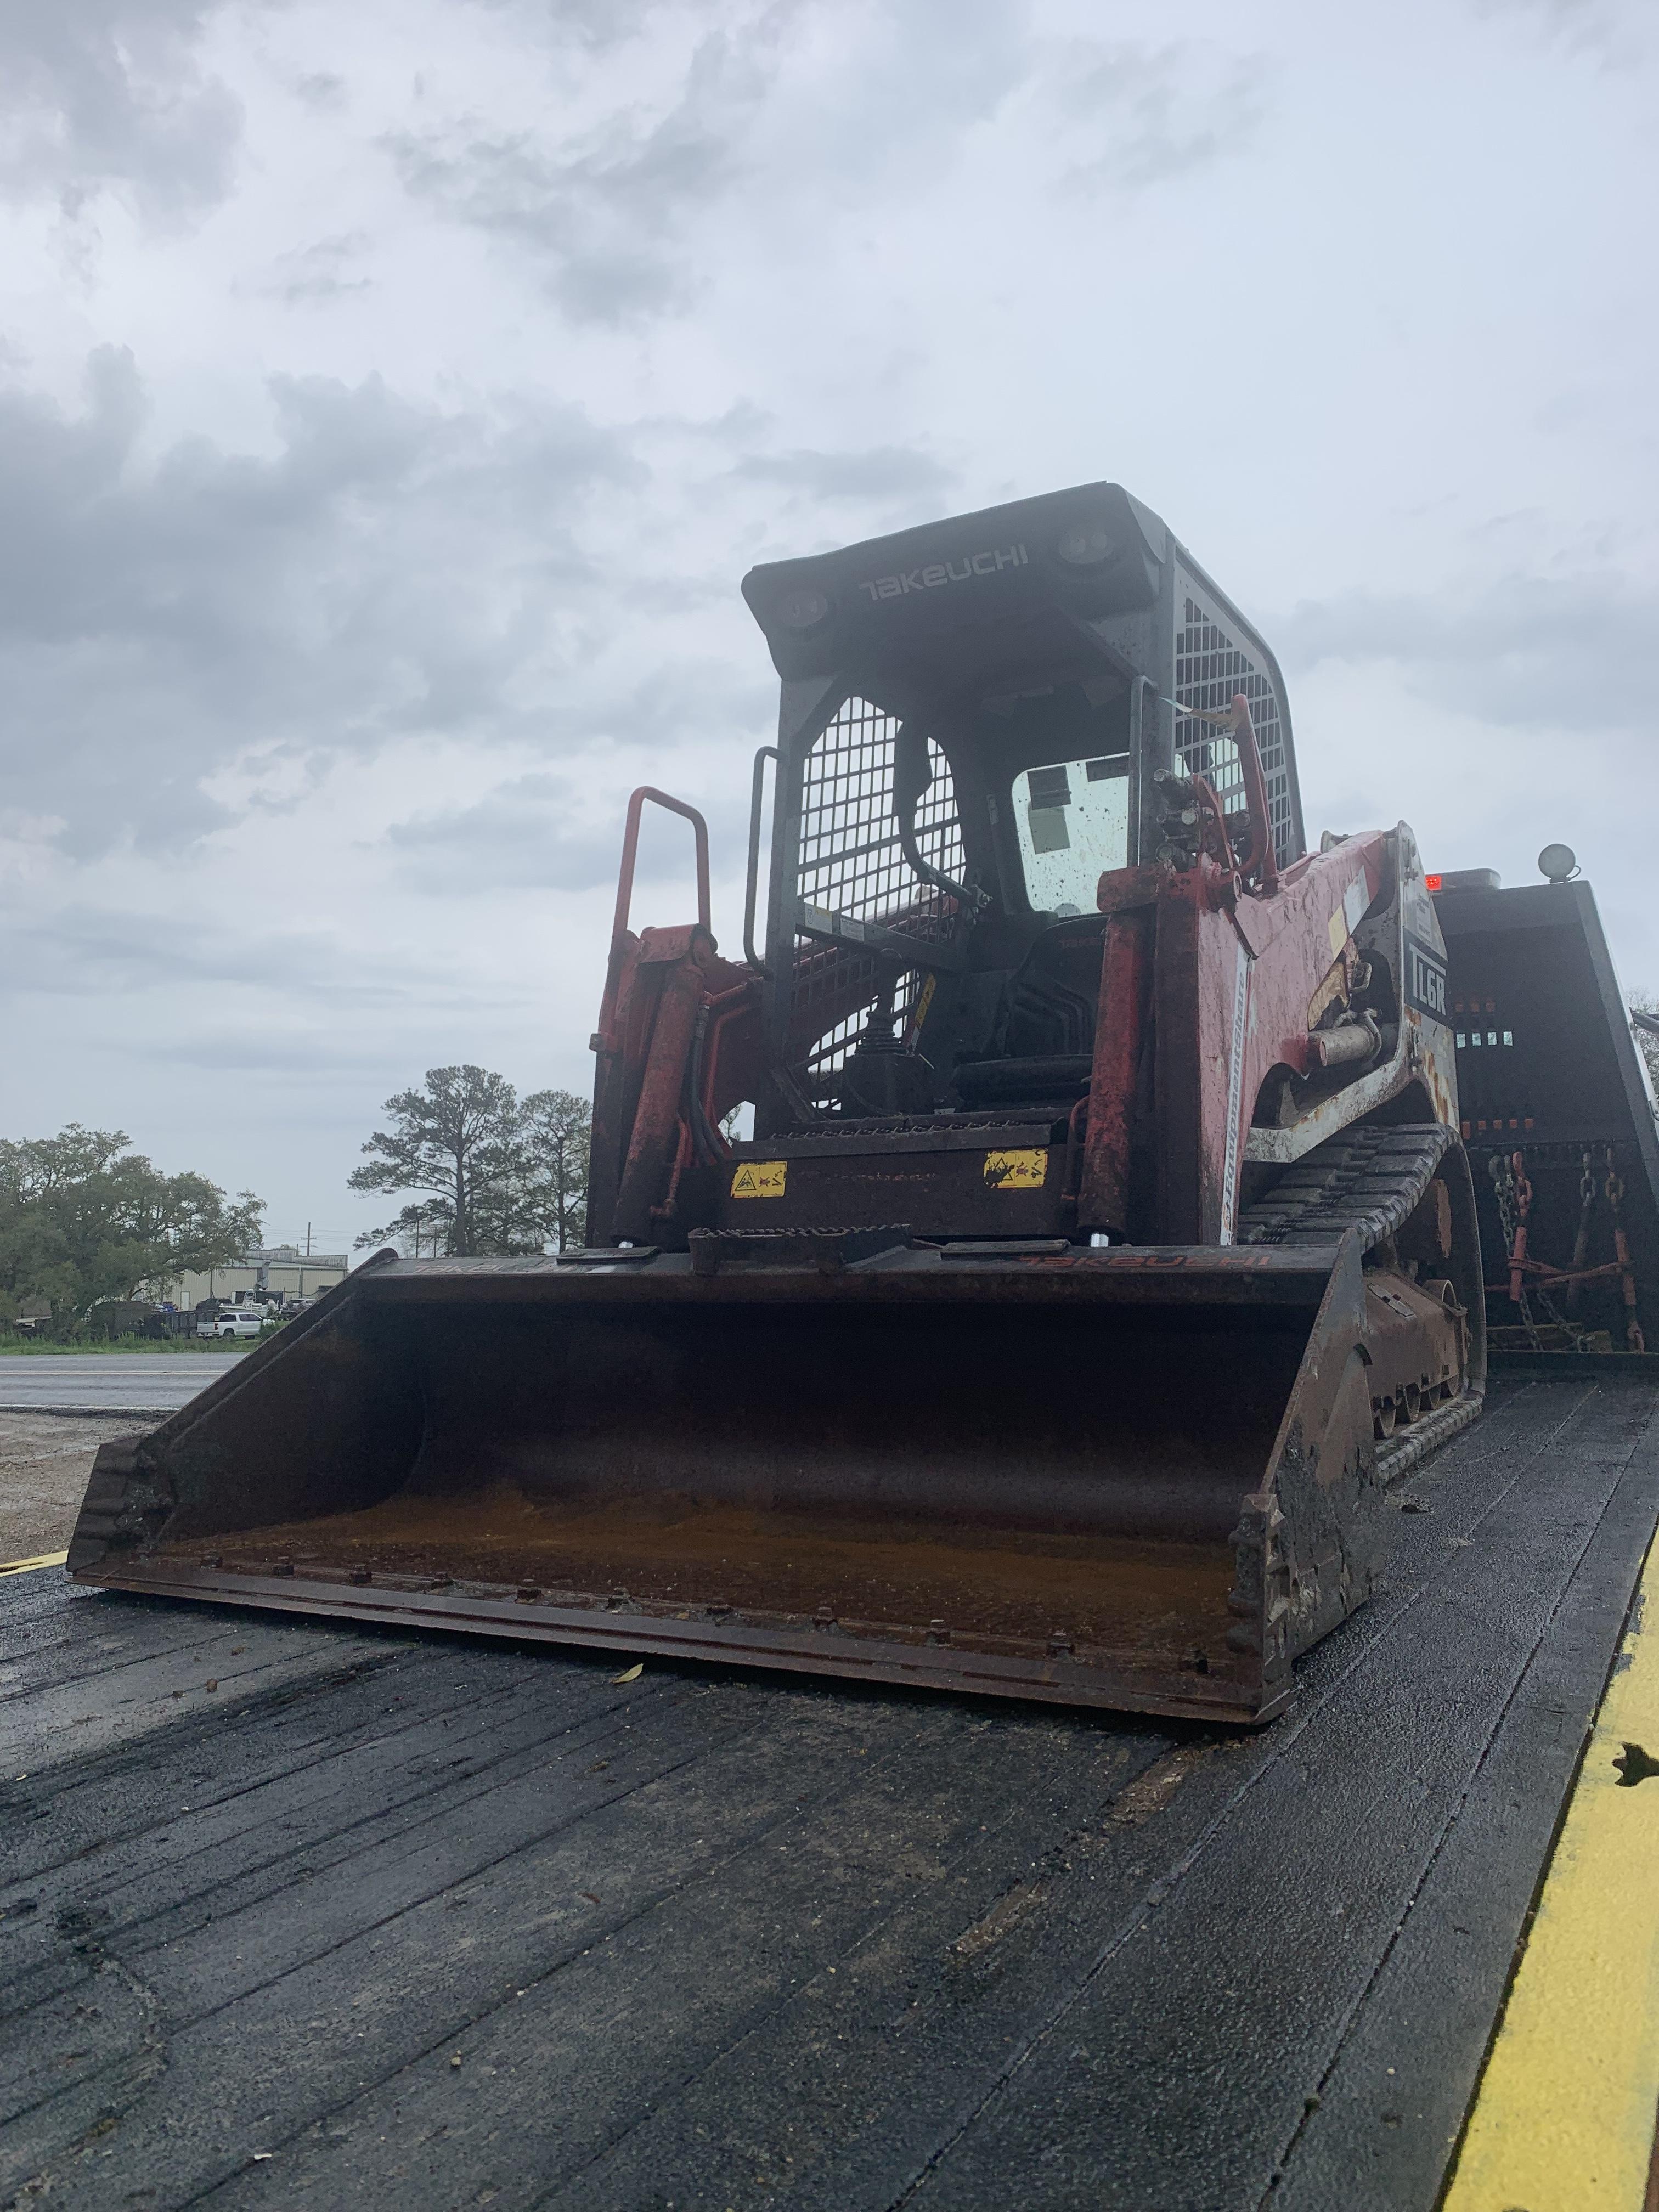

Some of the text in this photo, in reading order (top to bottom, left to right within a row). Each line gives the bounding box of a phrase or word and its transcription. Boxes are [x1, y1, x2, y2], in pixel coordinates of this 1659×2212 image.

[859, 544, 1028, 601] TAKEUCHI
[1409, 943, 1446, 1015] TL6R
[1226, 972, 1244, 1199] EquipmentShare
